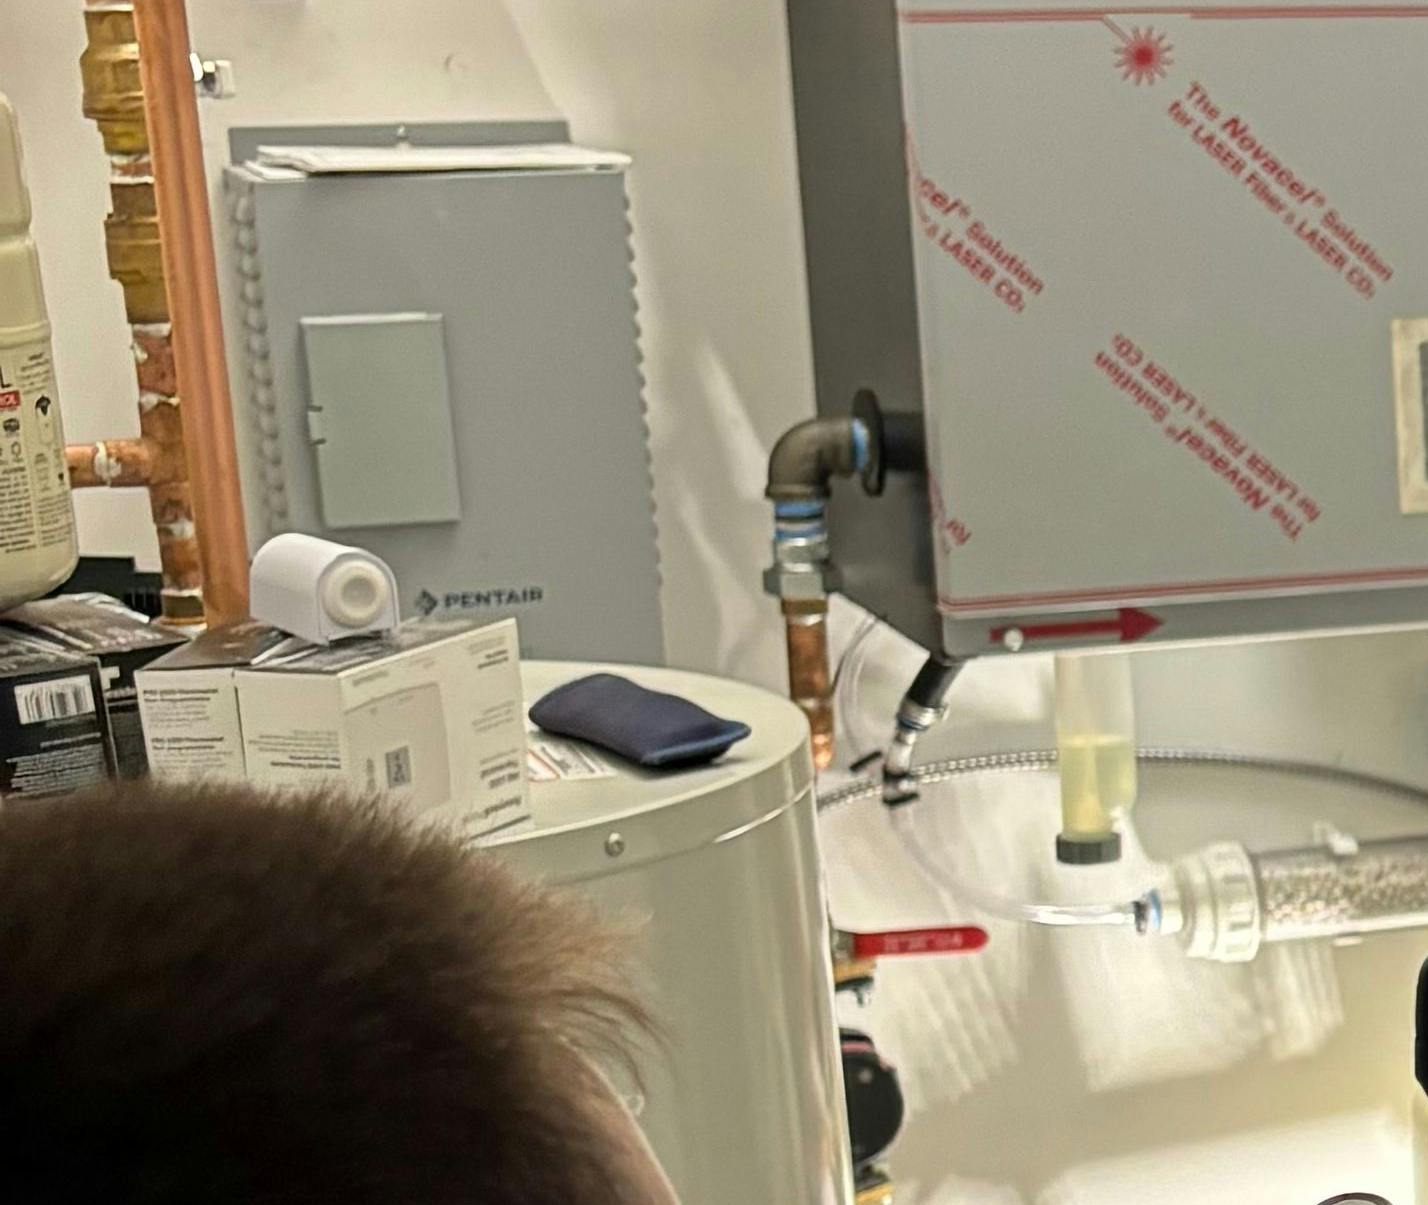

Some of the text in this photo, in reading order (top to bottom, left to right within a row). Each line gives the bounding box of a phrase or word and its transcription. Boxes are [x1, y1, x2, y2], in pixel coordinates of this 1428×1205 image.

[1192, 124, 1246, 177] LASER
[1295, 217, 1347, 271] LASER
[939, 229, 996, 284] LASER
[966, 219, 1044, 295] Solution
[1321, 208, 1394, 282] Solution
[1095, 351, 1169, 424] Solution
[1142, 361, 1197, 412] LASER
[1246, 451, 1298, 500] LASER
